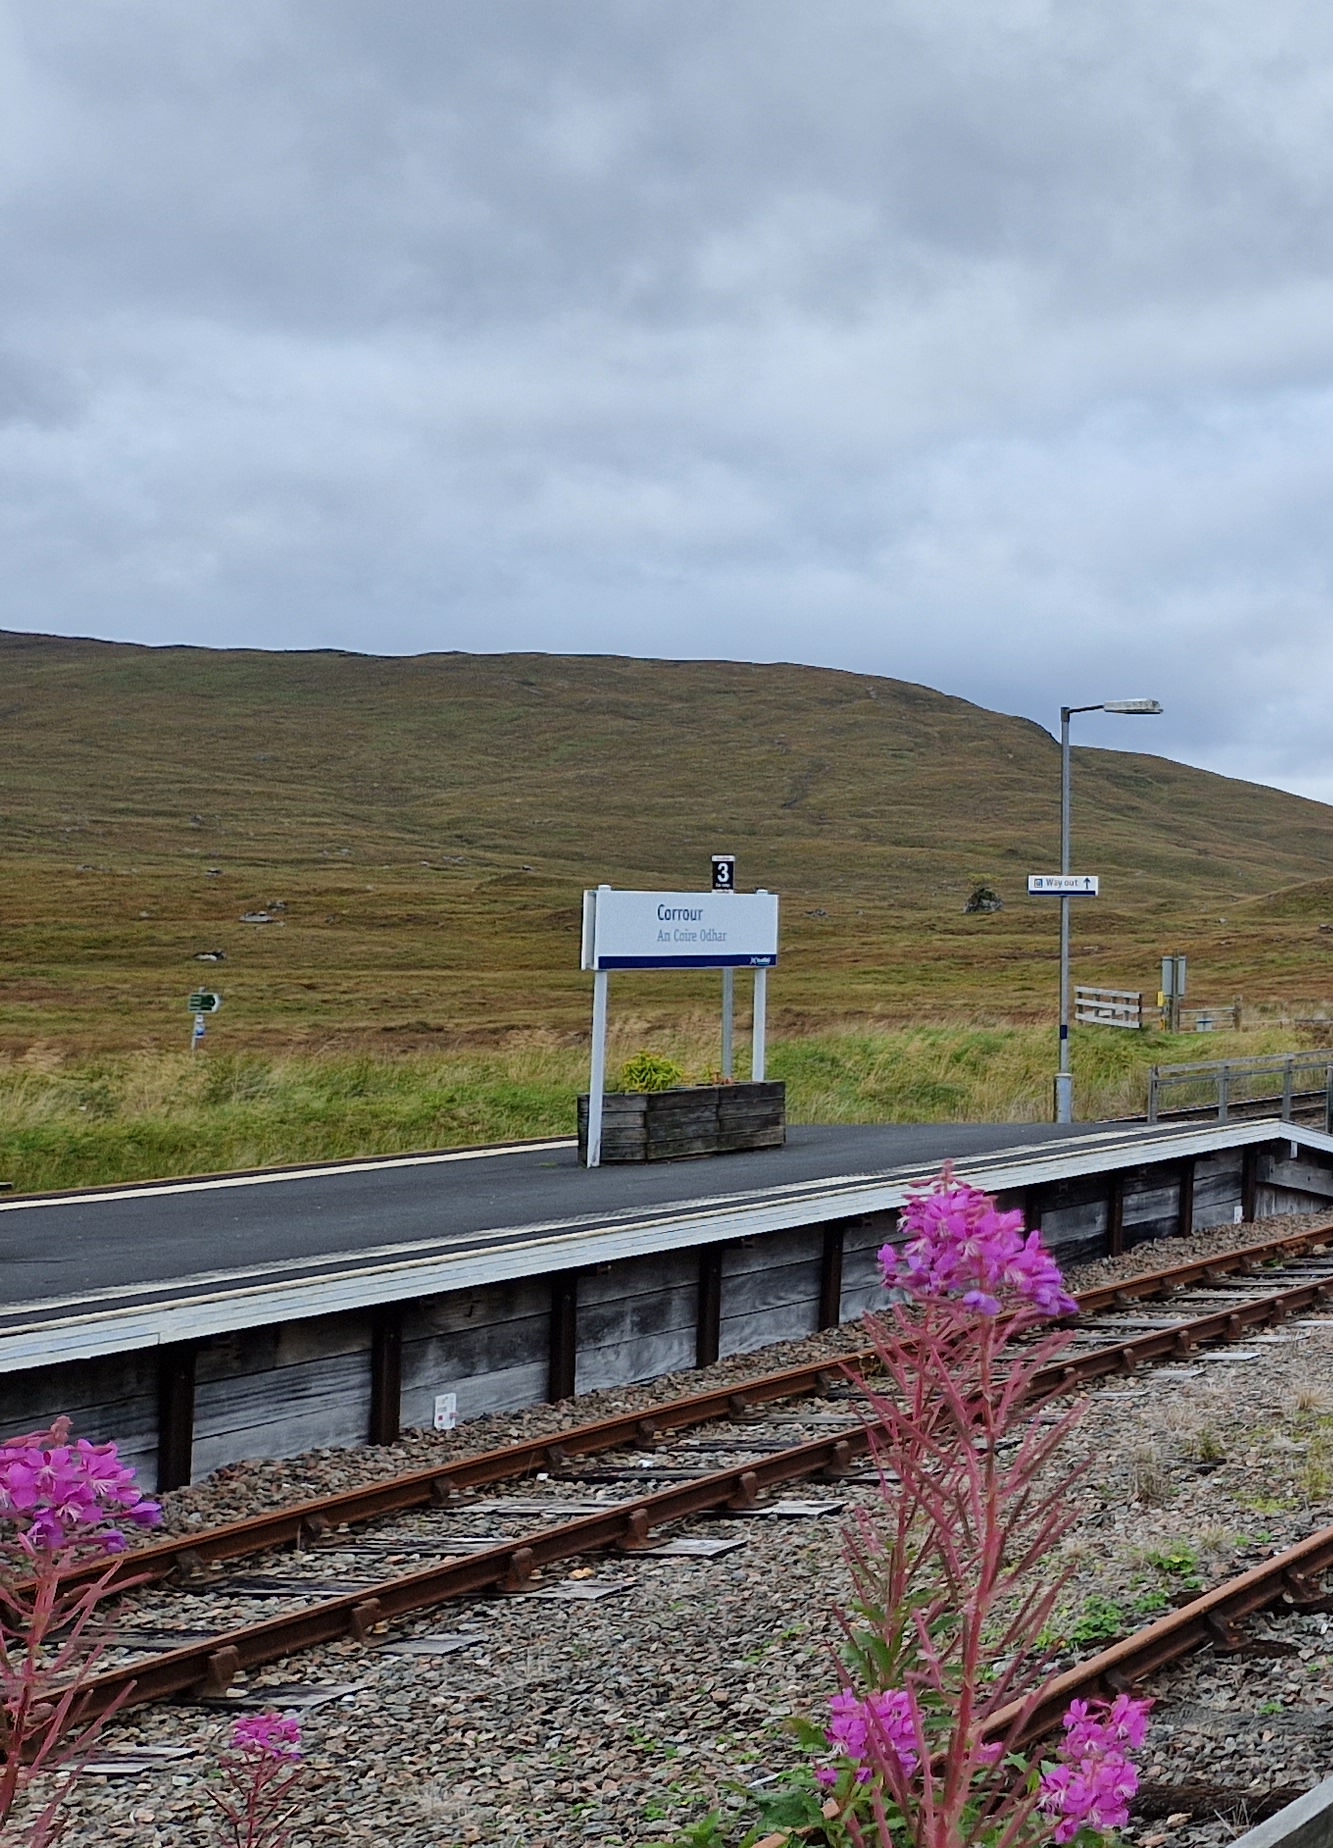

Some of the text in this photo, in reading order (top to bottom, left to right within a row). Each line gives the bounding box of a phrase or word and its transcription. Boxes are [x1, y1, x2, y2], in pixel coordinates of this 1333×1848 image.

[717, 862, 730, 883] 3
[1046, 878, 1078, 889] Way out
[657, 903, 703, 921] Corrour
[657, 929, 727, 942] An Coire Odhar
